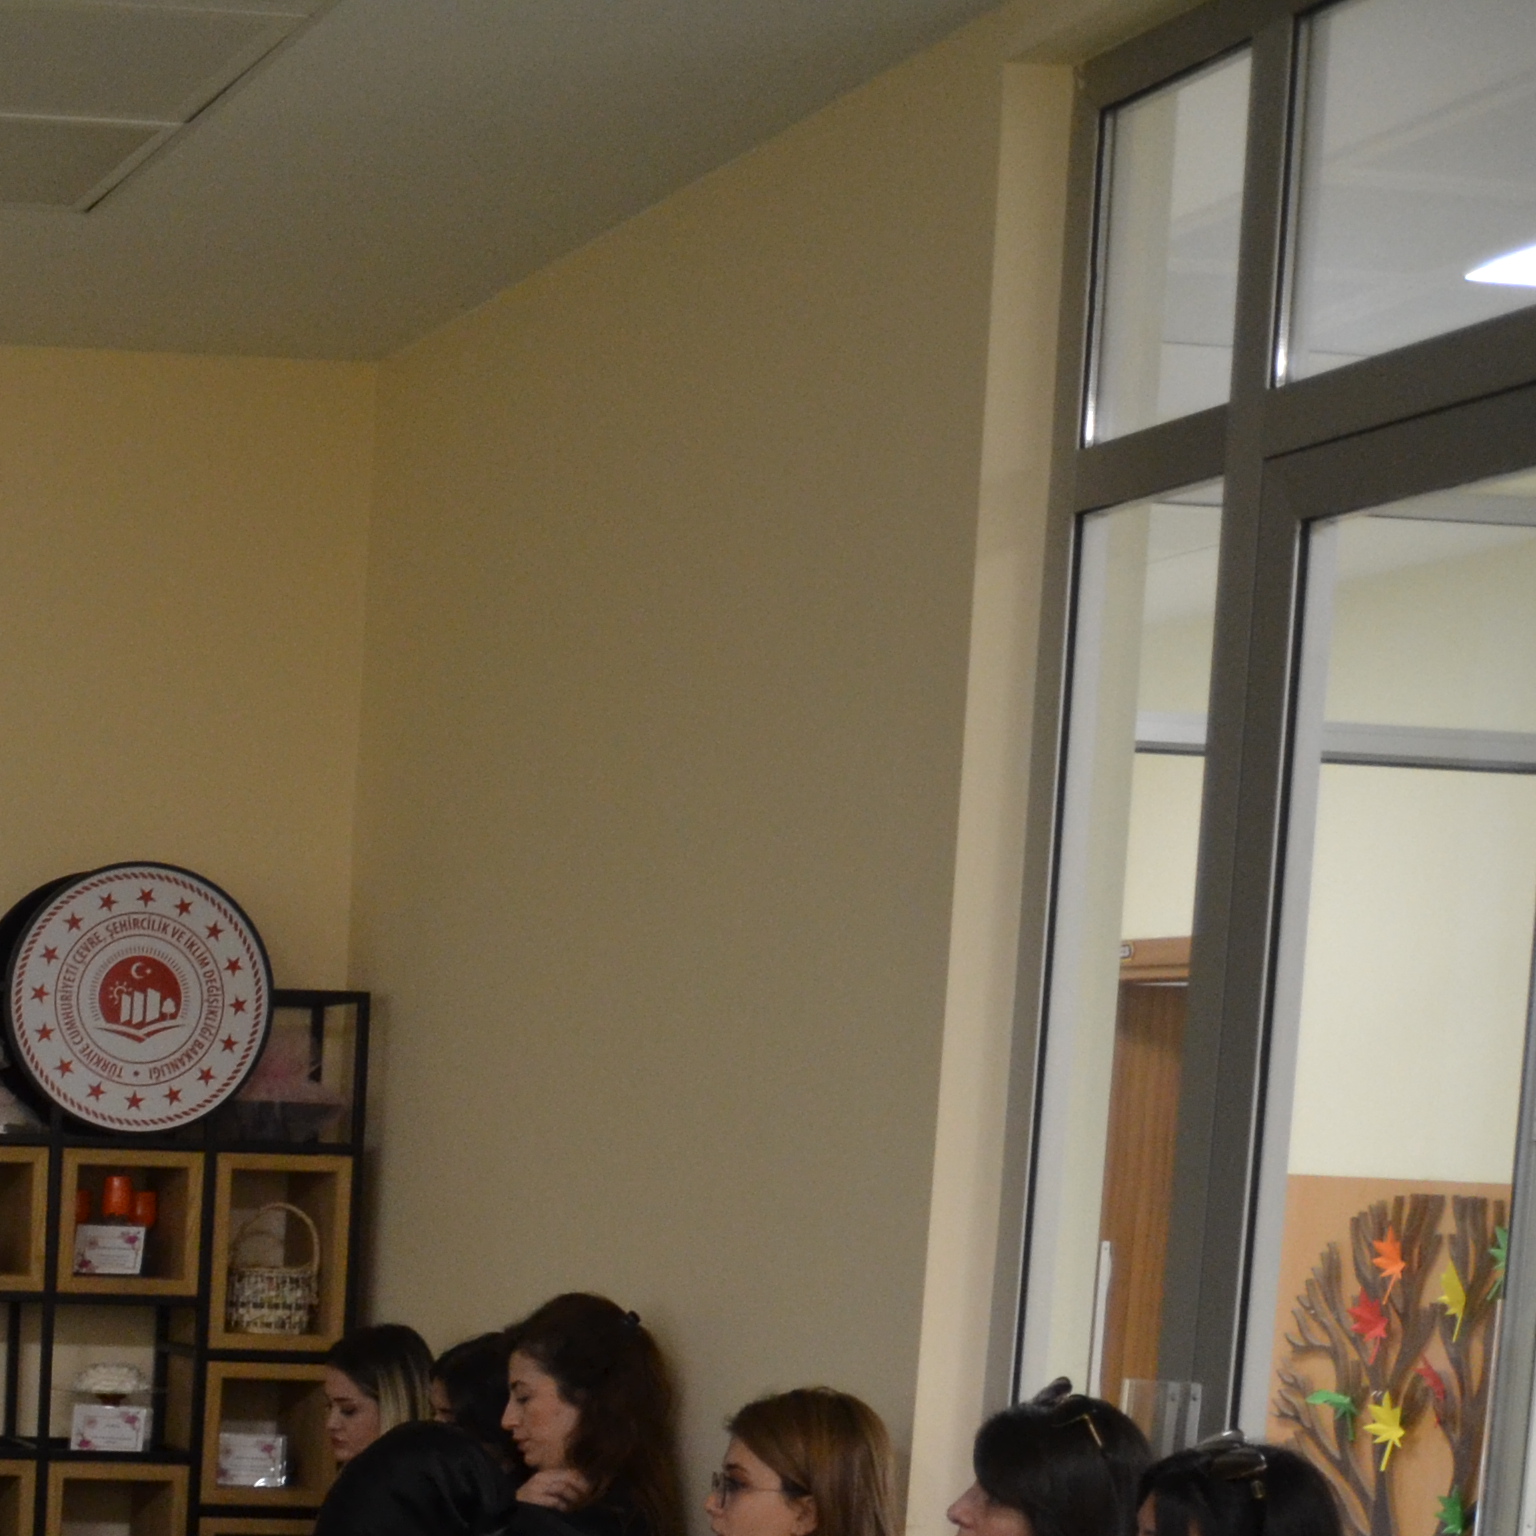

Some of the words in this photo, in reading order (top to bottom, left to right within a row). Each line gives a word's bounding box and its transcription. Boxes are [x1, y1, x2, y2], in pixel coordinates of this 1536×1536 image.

[105, 915, 170, 940] ŞEHİRCİLİK
[172, 925, 187, 943] VE
[184, 936, 211, 969] İKLİM
[59, 964, 84, 1045] CUMHURİYETİ
[78, 1043, 124, 1079] TÜRKİYE
[148, 1038, 205, 1081] BAKANLIĞI
